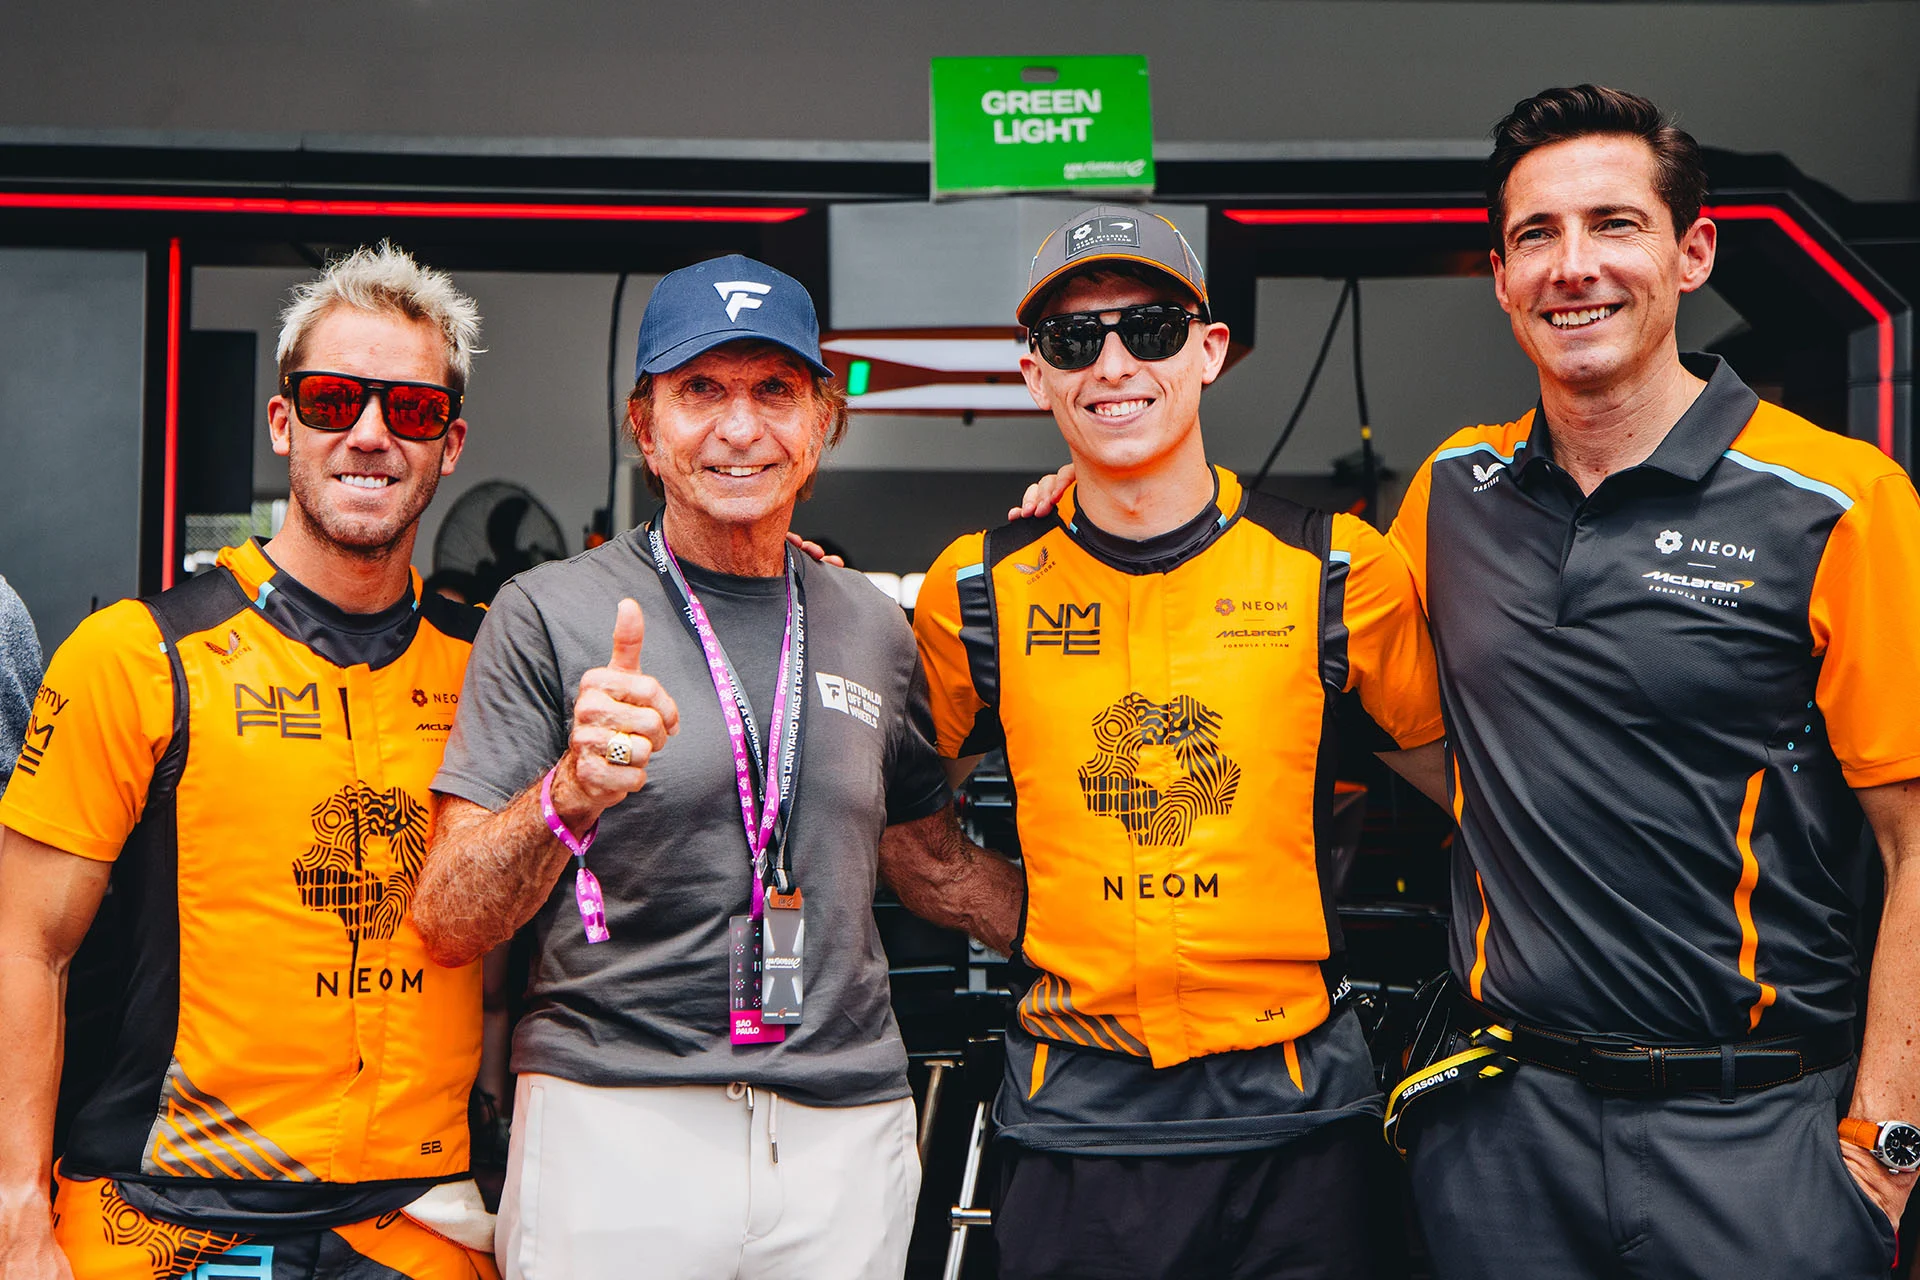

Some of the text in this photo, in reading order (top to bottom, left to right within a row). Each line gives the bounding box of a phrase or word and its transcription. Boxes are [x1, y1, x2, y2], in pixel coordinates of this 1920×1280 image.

[981, 88, 1102, 116] GREEN
[993, 117, 1094, 144] LIGHT
[1691, 538, 1756, 562] NEOM
[1642, 571, 1741, 594] McLaren
[1242, 601, 1288, 611] NEOM
[1648, 585, 1696, 601] FORMULA
[1711, 597, 1738, 608] TEAM
[796, 603, 804, 641] BOTTLE
[795, 642, 804, 684] PLASTIC
[433, 693, 458, 704] NEO
[791, 696, 802, 720] WAS
[783, 720, 799, 774] LANYARD
[780, 775, 791, 802] THIS
[1103, 873, 1219, 900] NEOM
[316, 967, 424, 998] NEOM
[735, 1026, 760, 1035] PAULO
[1401, 1067, 1459, 1100] SEASON 10
